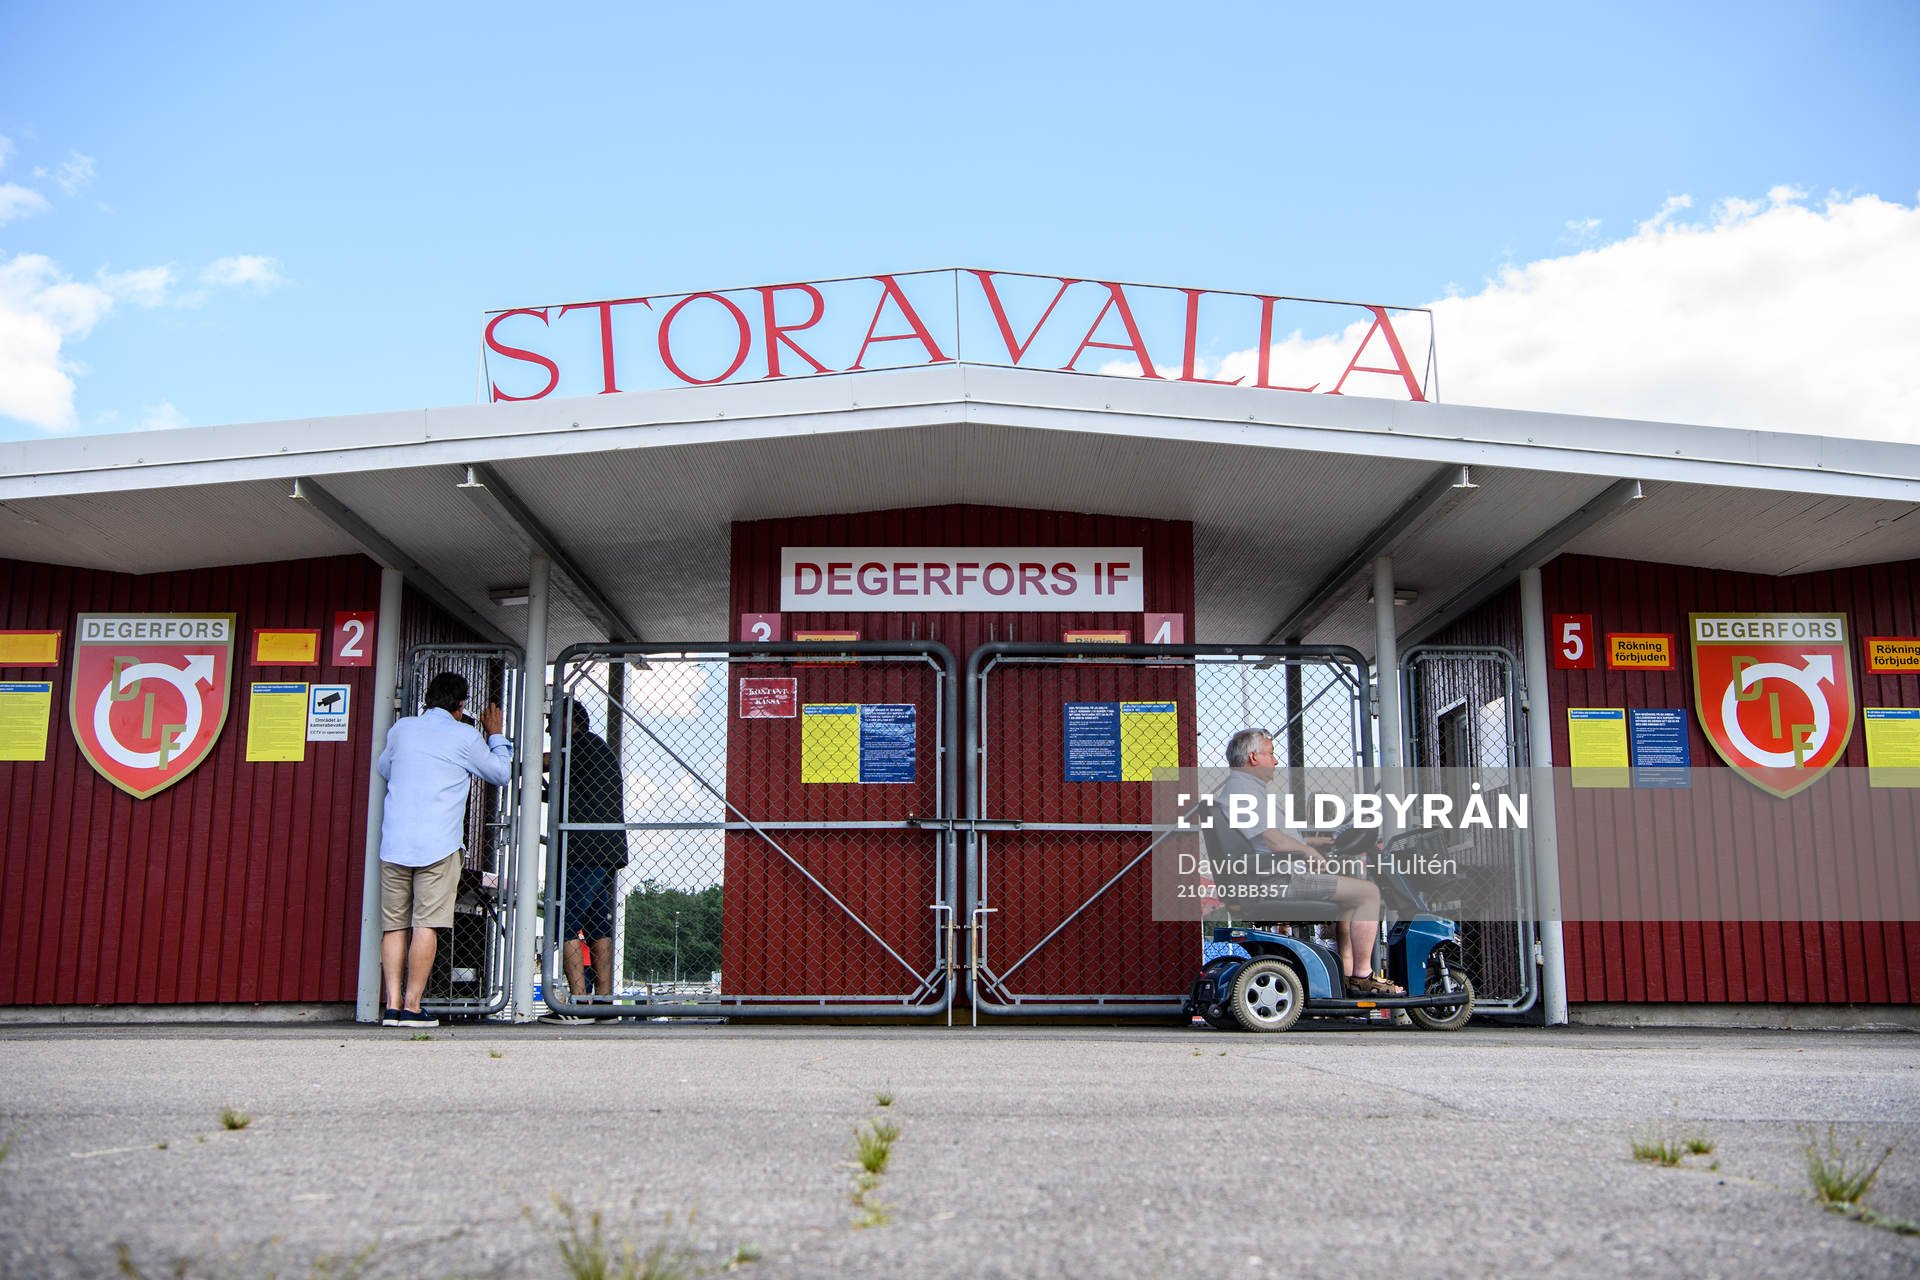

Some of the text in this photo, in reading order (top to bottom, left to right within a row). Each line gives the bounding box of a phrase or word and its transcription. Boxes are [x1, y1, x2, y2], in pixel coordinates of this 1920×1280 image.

[485, 269, 1431, 402] STORA VALLA
[794, 562, 1131, 596] DEGERFORS IF
[87, 622, 224, 639] DEGERFORS
[340, 619, 365, 657] 2
[1701, 622, 1837, 638] DEGERFORS
[1563, 623, 1584, 660] 5
[1618, 641, 1662, 652] Rökning
[1876, 644, 1920, 655] Rökning
[1615, 652, 1667, 663] förbjuden
